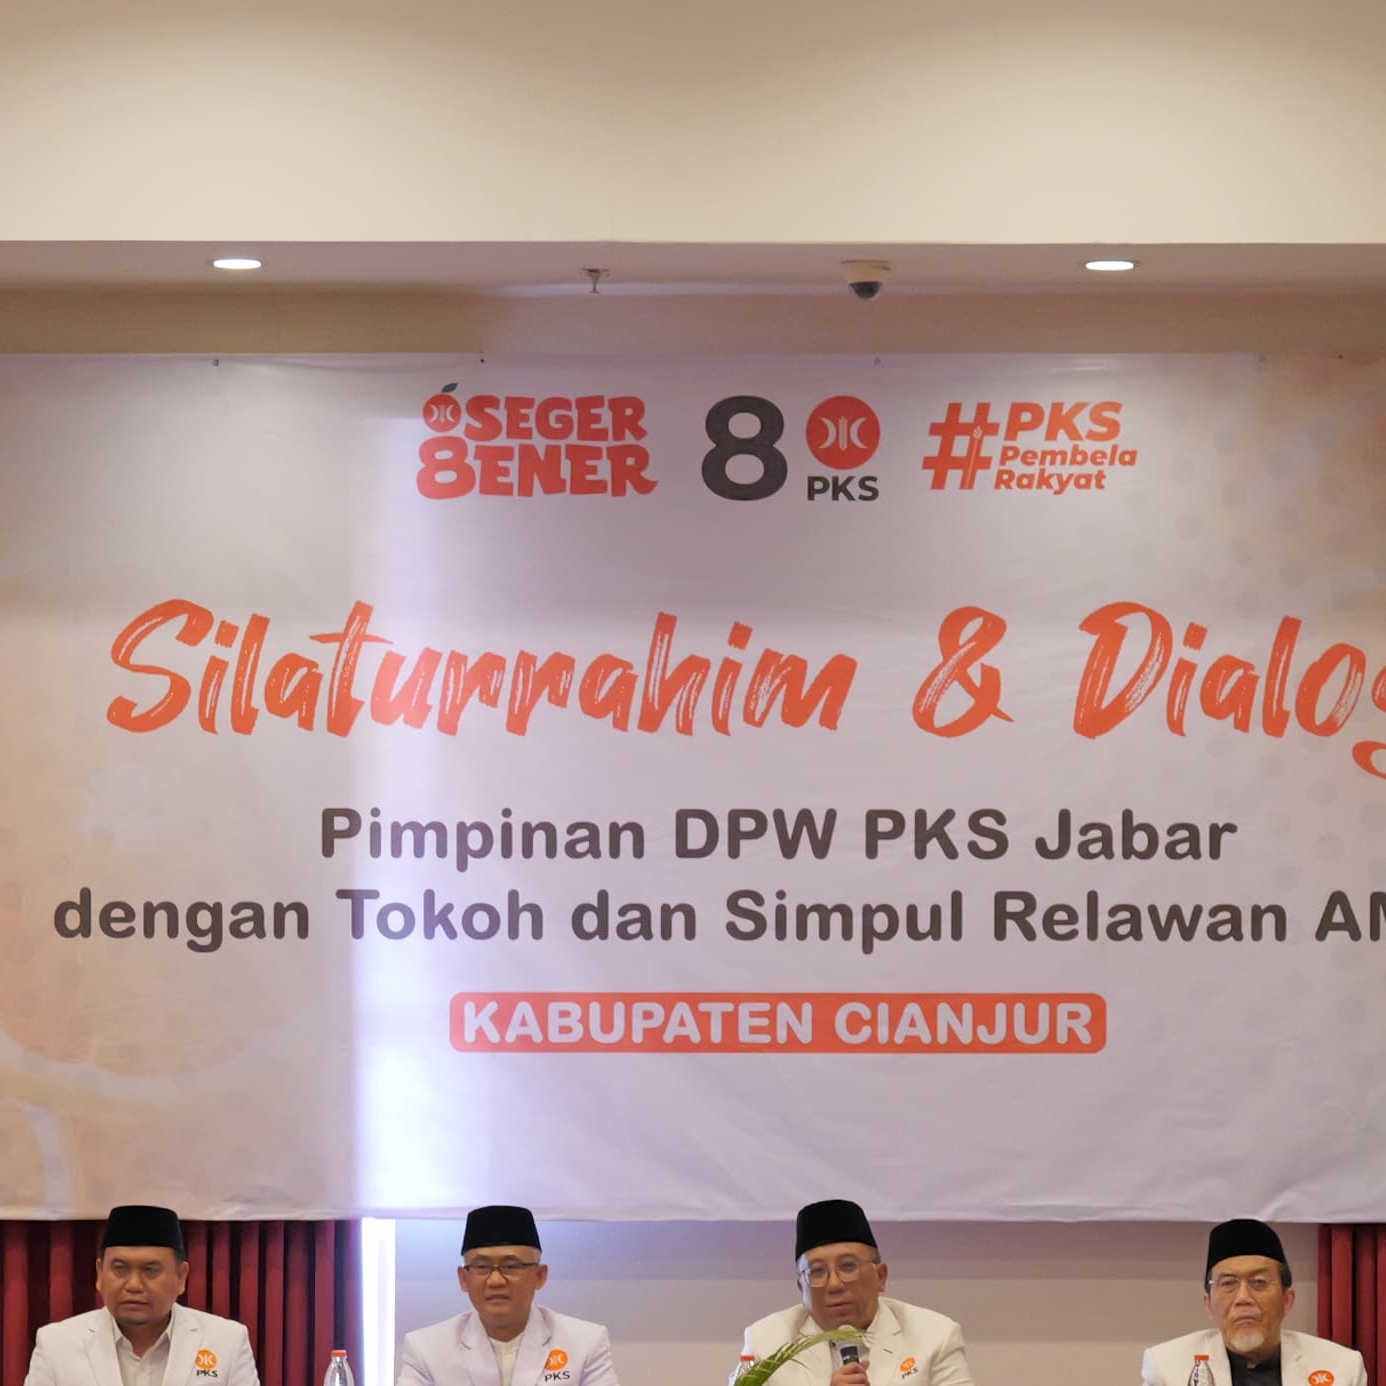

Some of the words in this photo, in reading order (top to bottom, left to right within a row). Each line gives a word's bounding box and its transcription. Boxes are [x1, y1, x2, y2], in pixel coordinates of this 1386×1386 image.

[463, 394, 649, 443] SEGER
[701, 395, 787, 502] 8
[998, 444, 1138, 468] Pembela
[806, 475, 879, 502] PKS
[994, 468, 1106, 496] Rakyat
[107, 598, 858, 737] Silaturrahim
[912, 605, 1015, 738] &
[320, 807, 647, 873] Pimpinan
[676, 809, 839, 860] DPW
[865, 808, 1010, 860] PKS
[1035, 808, 1237, 862] Jabar
[53, 888, 309, 954] dengan
[336, 888, 544, 941] Tokoh
[570, 888, 697, 941] dan
[725, 888, 964, 954] Simpul
[992, 888, 1286, 941] Relawan
[464, 1001, 814, 1046] KABUPATEN
[833, 1001, 1094, 1048] CIANJUR
[196, 1369, 218, 1378] PKS
[544, 1370, 570, 1382] PKS
